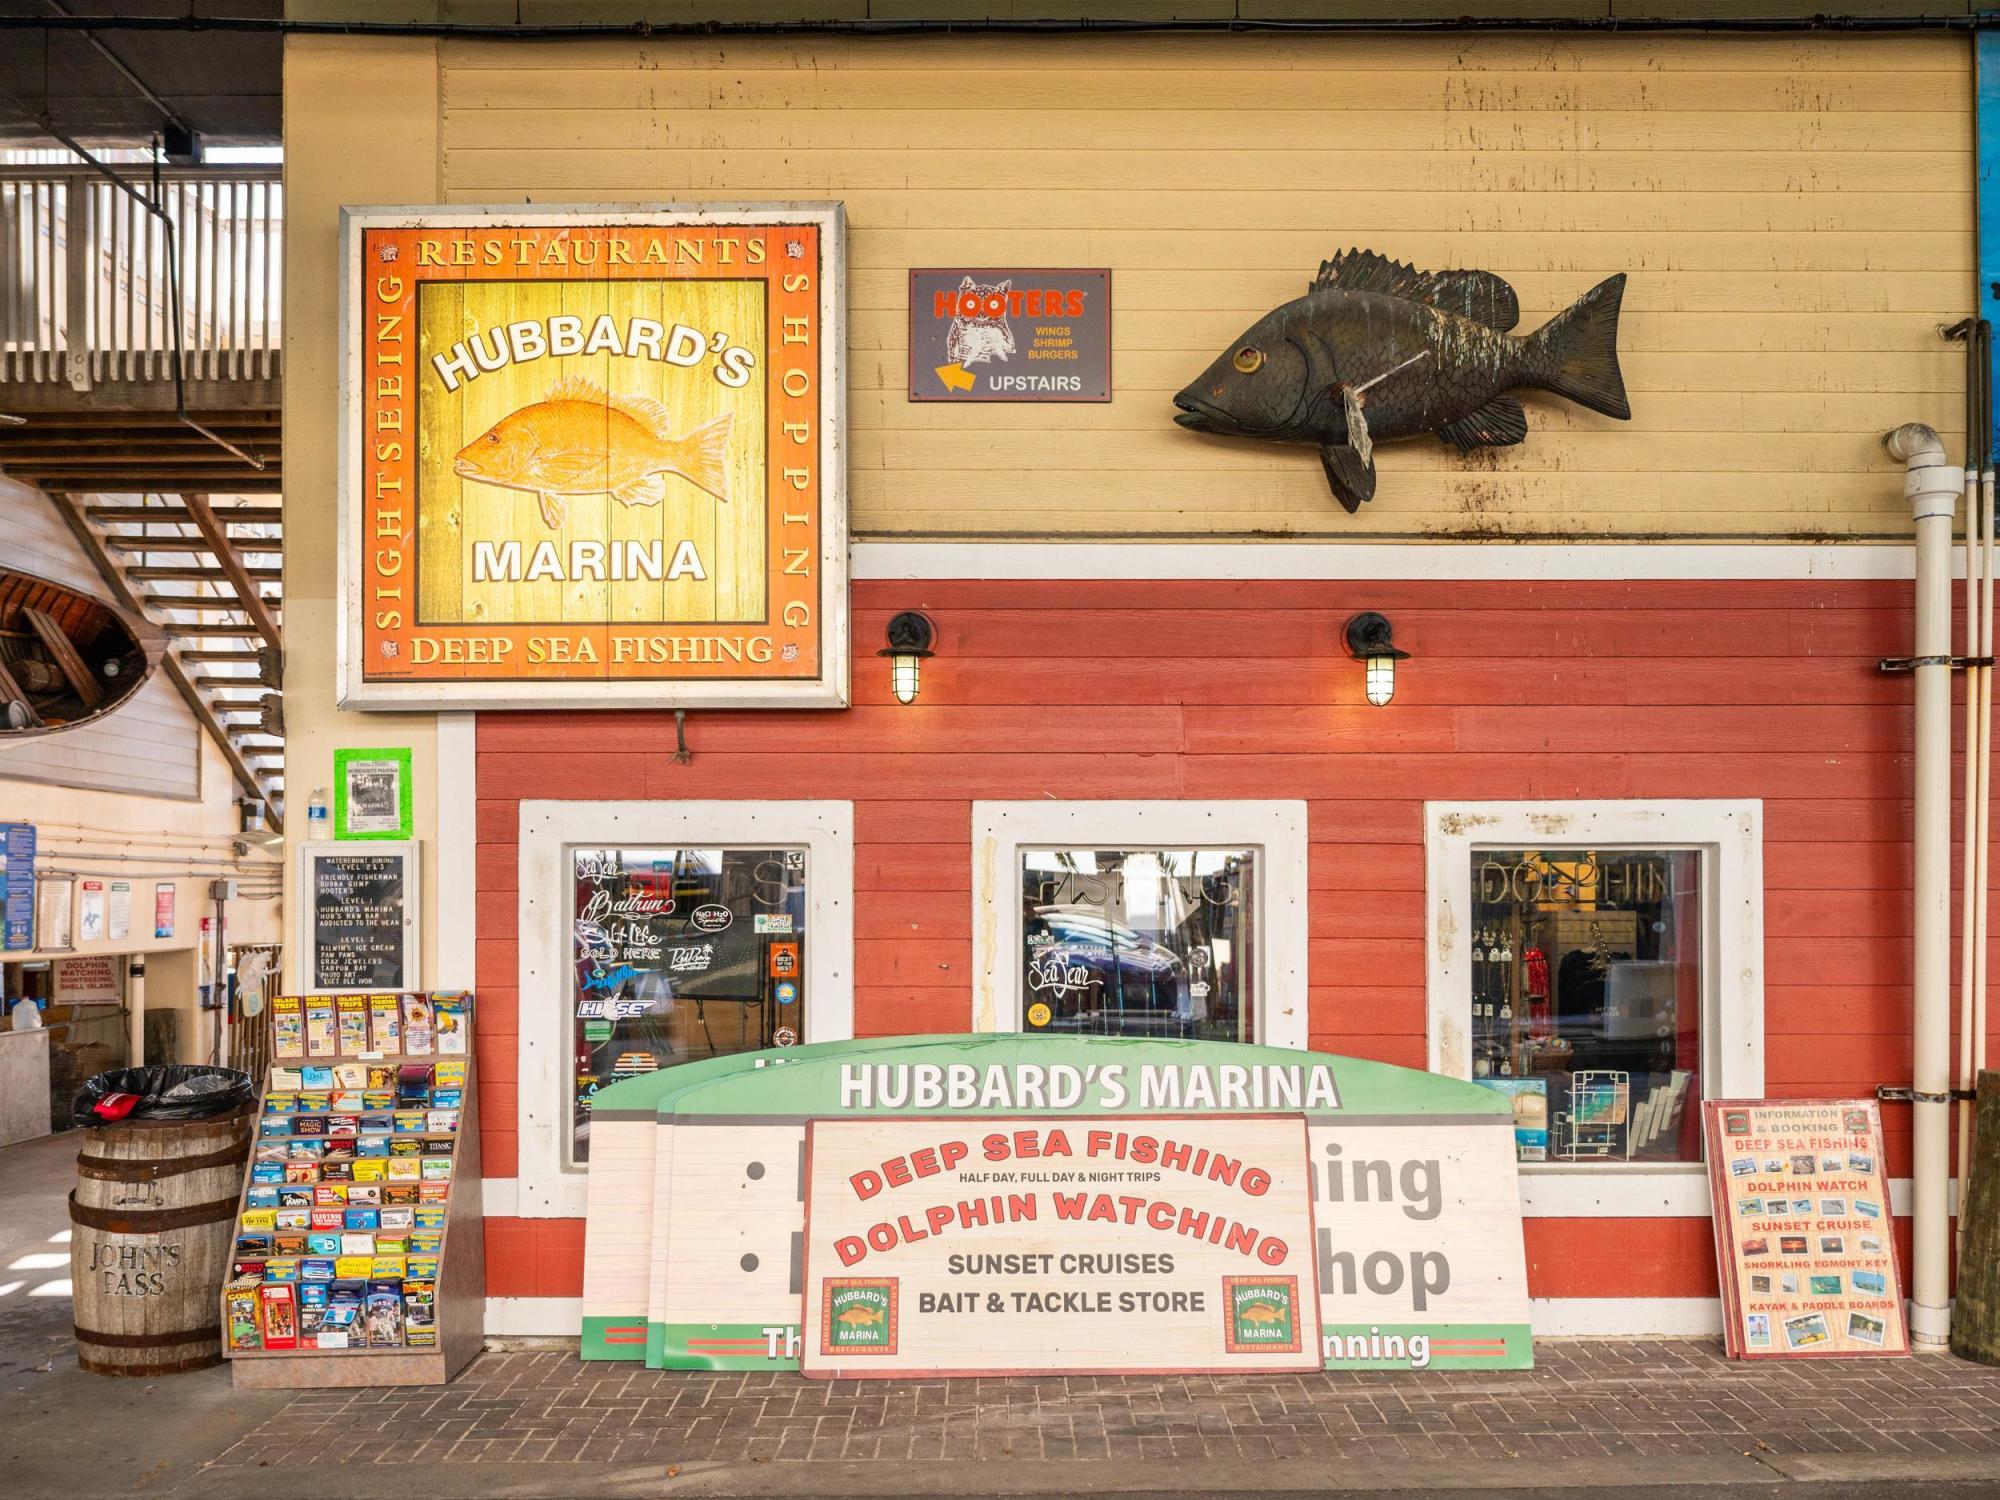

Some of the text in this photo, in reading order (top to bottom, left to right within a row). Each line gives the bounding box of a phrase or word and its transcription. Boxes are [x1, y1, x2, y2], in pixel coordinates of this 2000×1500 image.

[417, 237, 766, 266] RESTAURANTS
[934, 290, 1085, 319] HOOTERS
[1036, 327, 1071, 336] WINGS
[1033, 338, 1073, 348] SHRIMP
[432, 315, 756, 394] HUBBARD'S
[1028, 350, 1078, 360] BURGERS
[989, 376, 1082, 391] UPSTAIRS
[376, 274, 403, 631] SIGHTSEEING
[782, 272, 809, 628] SHOPPING
[472, 539, 707, 583] MARINA
[411, 637, 774, 664] DEEP SEA FISHING
[341, 897, 365, 905] LEVEL
[580, 947, 662, 960] SOLD HERE
[840, 1062, 1343, 1110] HUBBARD'S MARINA
[1754, 1109, 1839, 1119] INFORMATION
[1756, 1123, 1839, 1133] & BOOKING
[1735, 1137, 1869, 1151] DEEP SEA FISHING
[849, 1128, 1272, 1202] DEEP SEA FISHING
[959, 1172, 1161, 1184] HALF DAY, FULL DAY & NIGHT TRIPS
[1747, 1180, 1868, 1192] DOLPHIN WATCH
[834, 1192, 1289, 1268] DOLPHIN WATCHING
[1752, 1220, 1872, 1231] SUNSET CRUISE
[89, 1241, 182, 1272] JOHN'S
[947, 1253, 1175, 1275] SUNSET CRUISES
[1744, 1259, 1889, 1269] SNORKLING EGMONT KEY
[227, 1292, 255, 1301] GOLF
[834, 1290, 888, 1307] HUBBARD'S
[919, 1291, 1205, 1314] BAIT & TACKLE STORE
[1235, 1288, 1289, 1305] HUBBARD'S
[1749, 1300, 1895, 1312] KAYAK & PADDLE BOARDS
[840, 1331, 879, 1340] MARINA
[1244, 1329, 1283, 1338] MARINA
